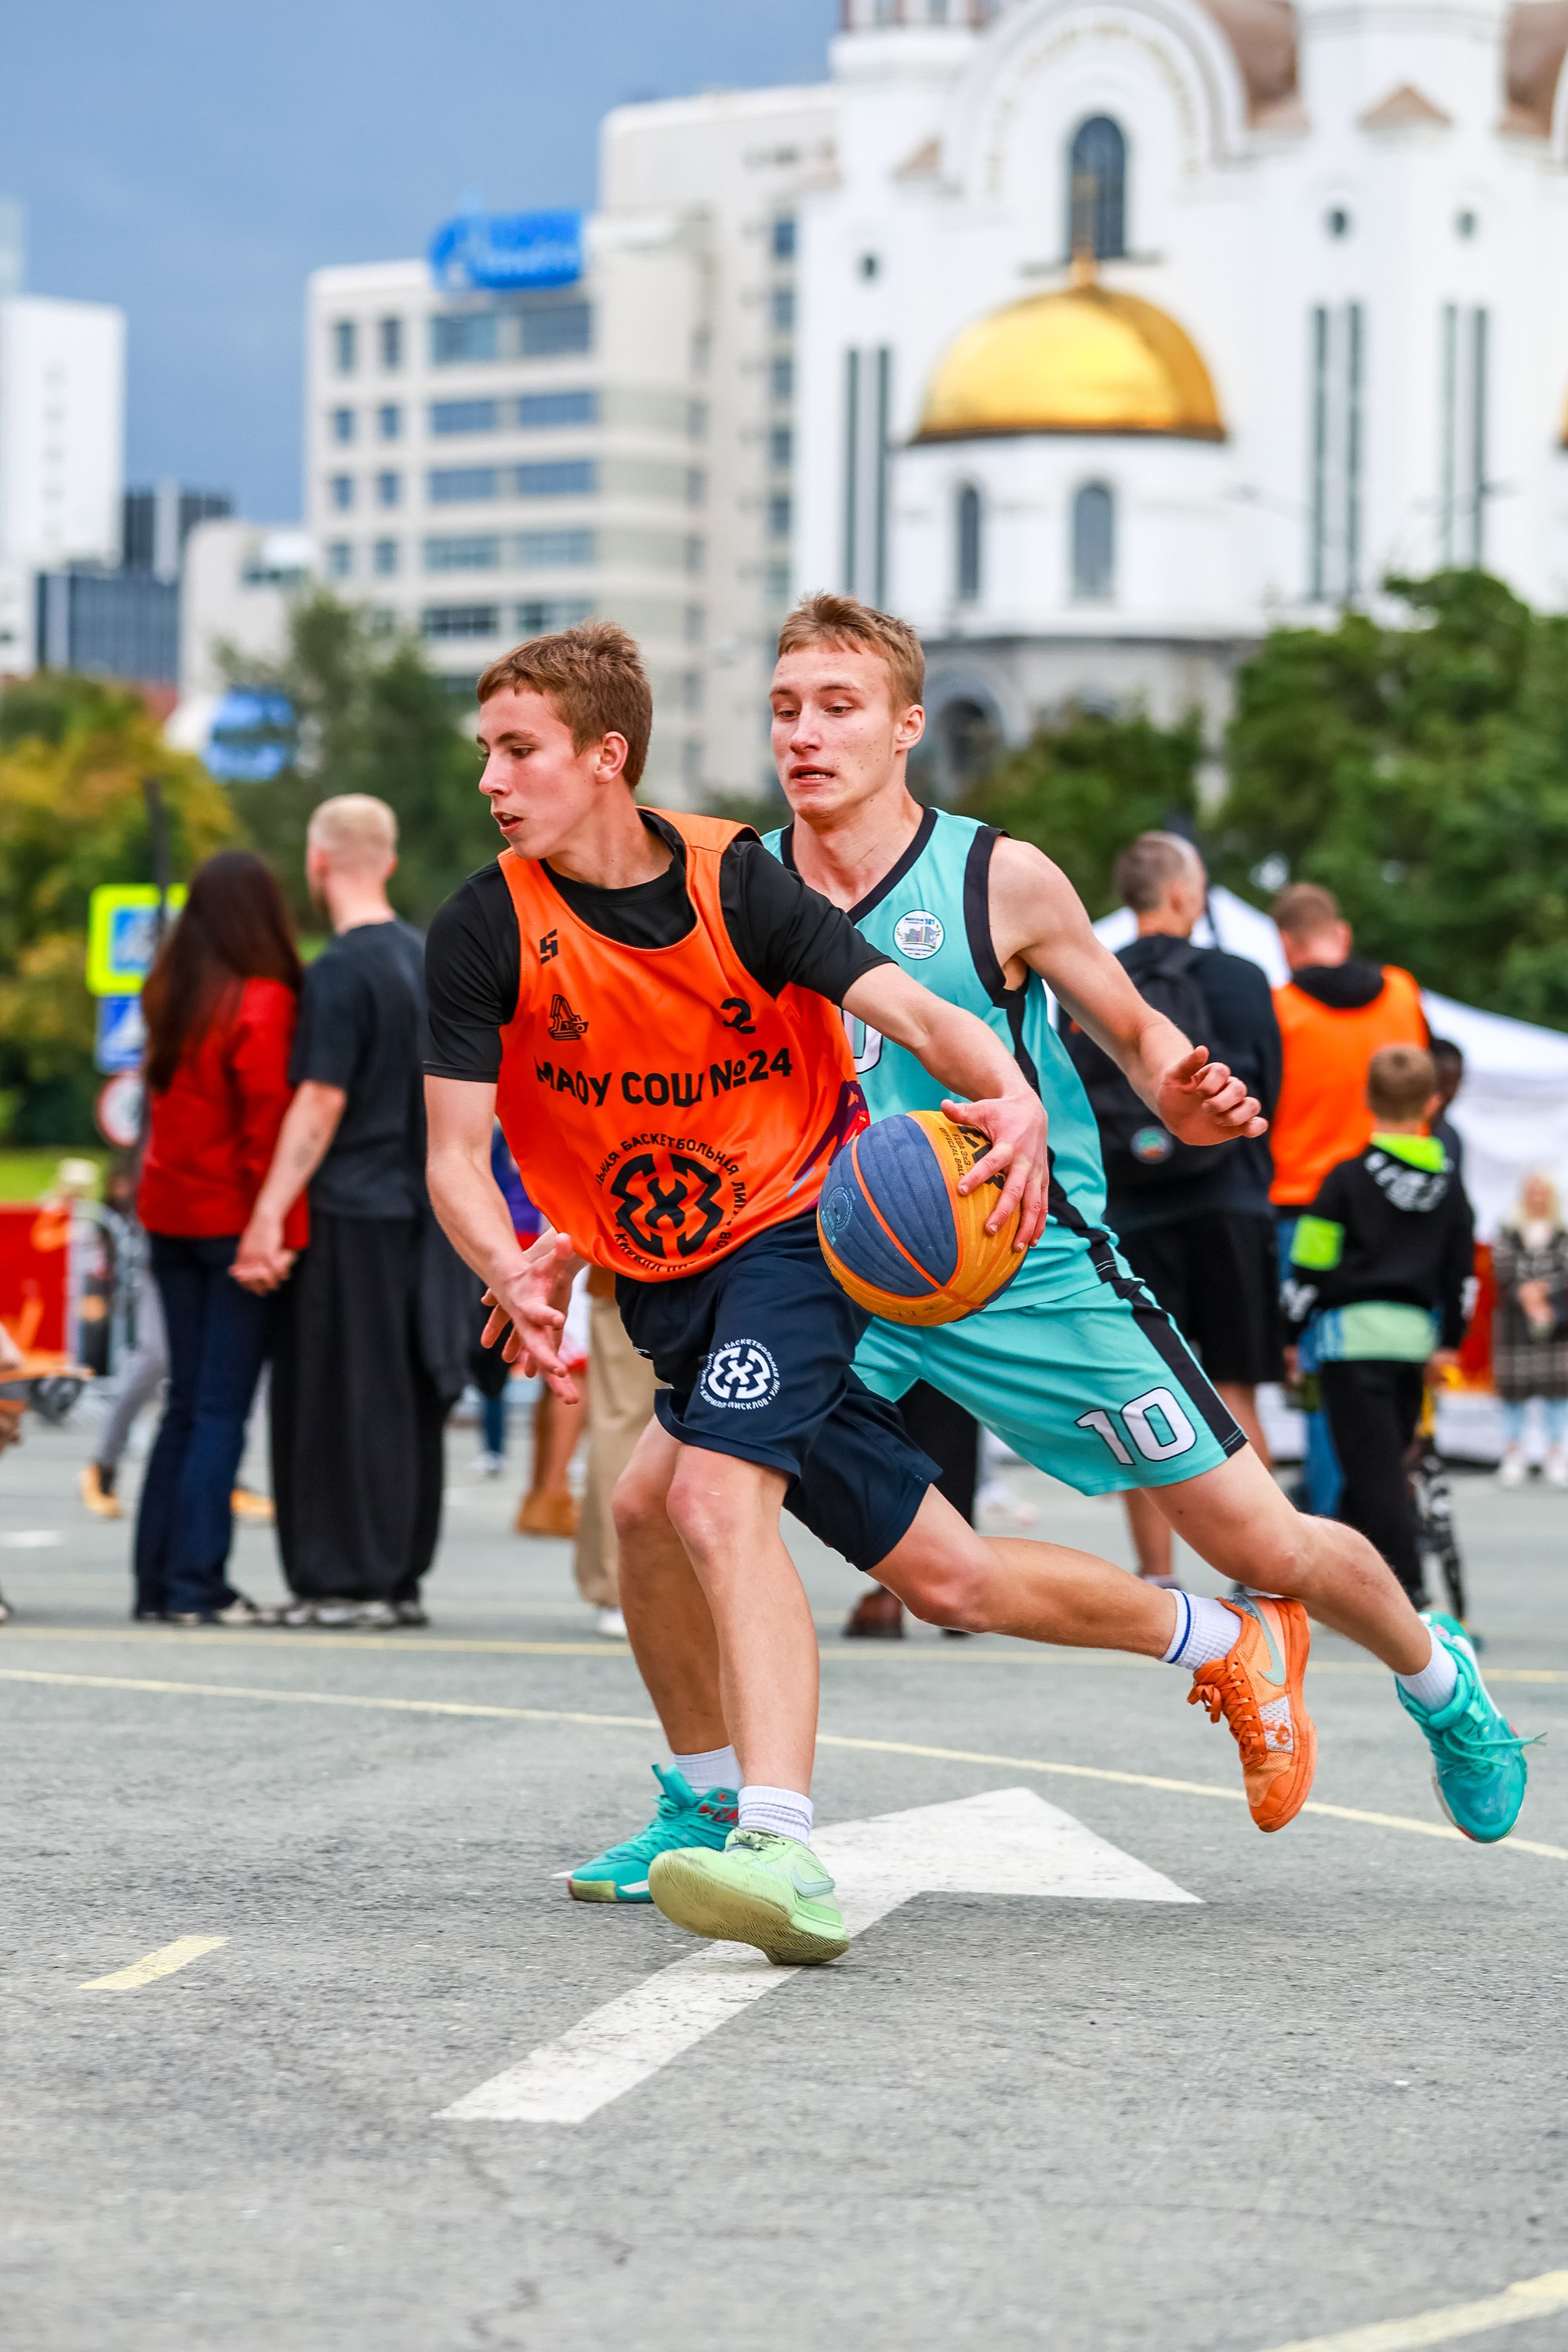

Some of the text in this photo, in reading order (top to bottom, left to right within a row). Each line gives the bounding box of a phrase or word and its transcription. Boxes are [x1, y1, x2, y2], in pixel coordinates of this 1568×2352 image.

[719, 996, 757, 1035] 2
[533, 1047, 793, 1108] МАОУ СОШ №24
[619, 1132, 740, 1176] БАСКЕТБОЛЬНАЯ
[939, 1127, 965, 1178] OFFICIAL BALL
[952, 1133, 965, 1150] FIBA
[724, 1338, 781, 1398] БАСКЕТБОЛЬНАЯ ЛИГА
[1073, 1386, 1198, 1466] 10
